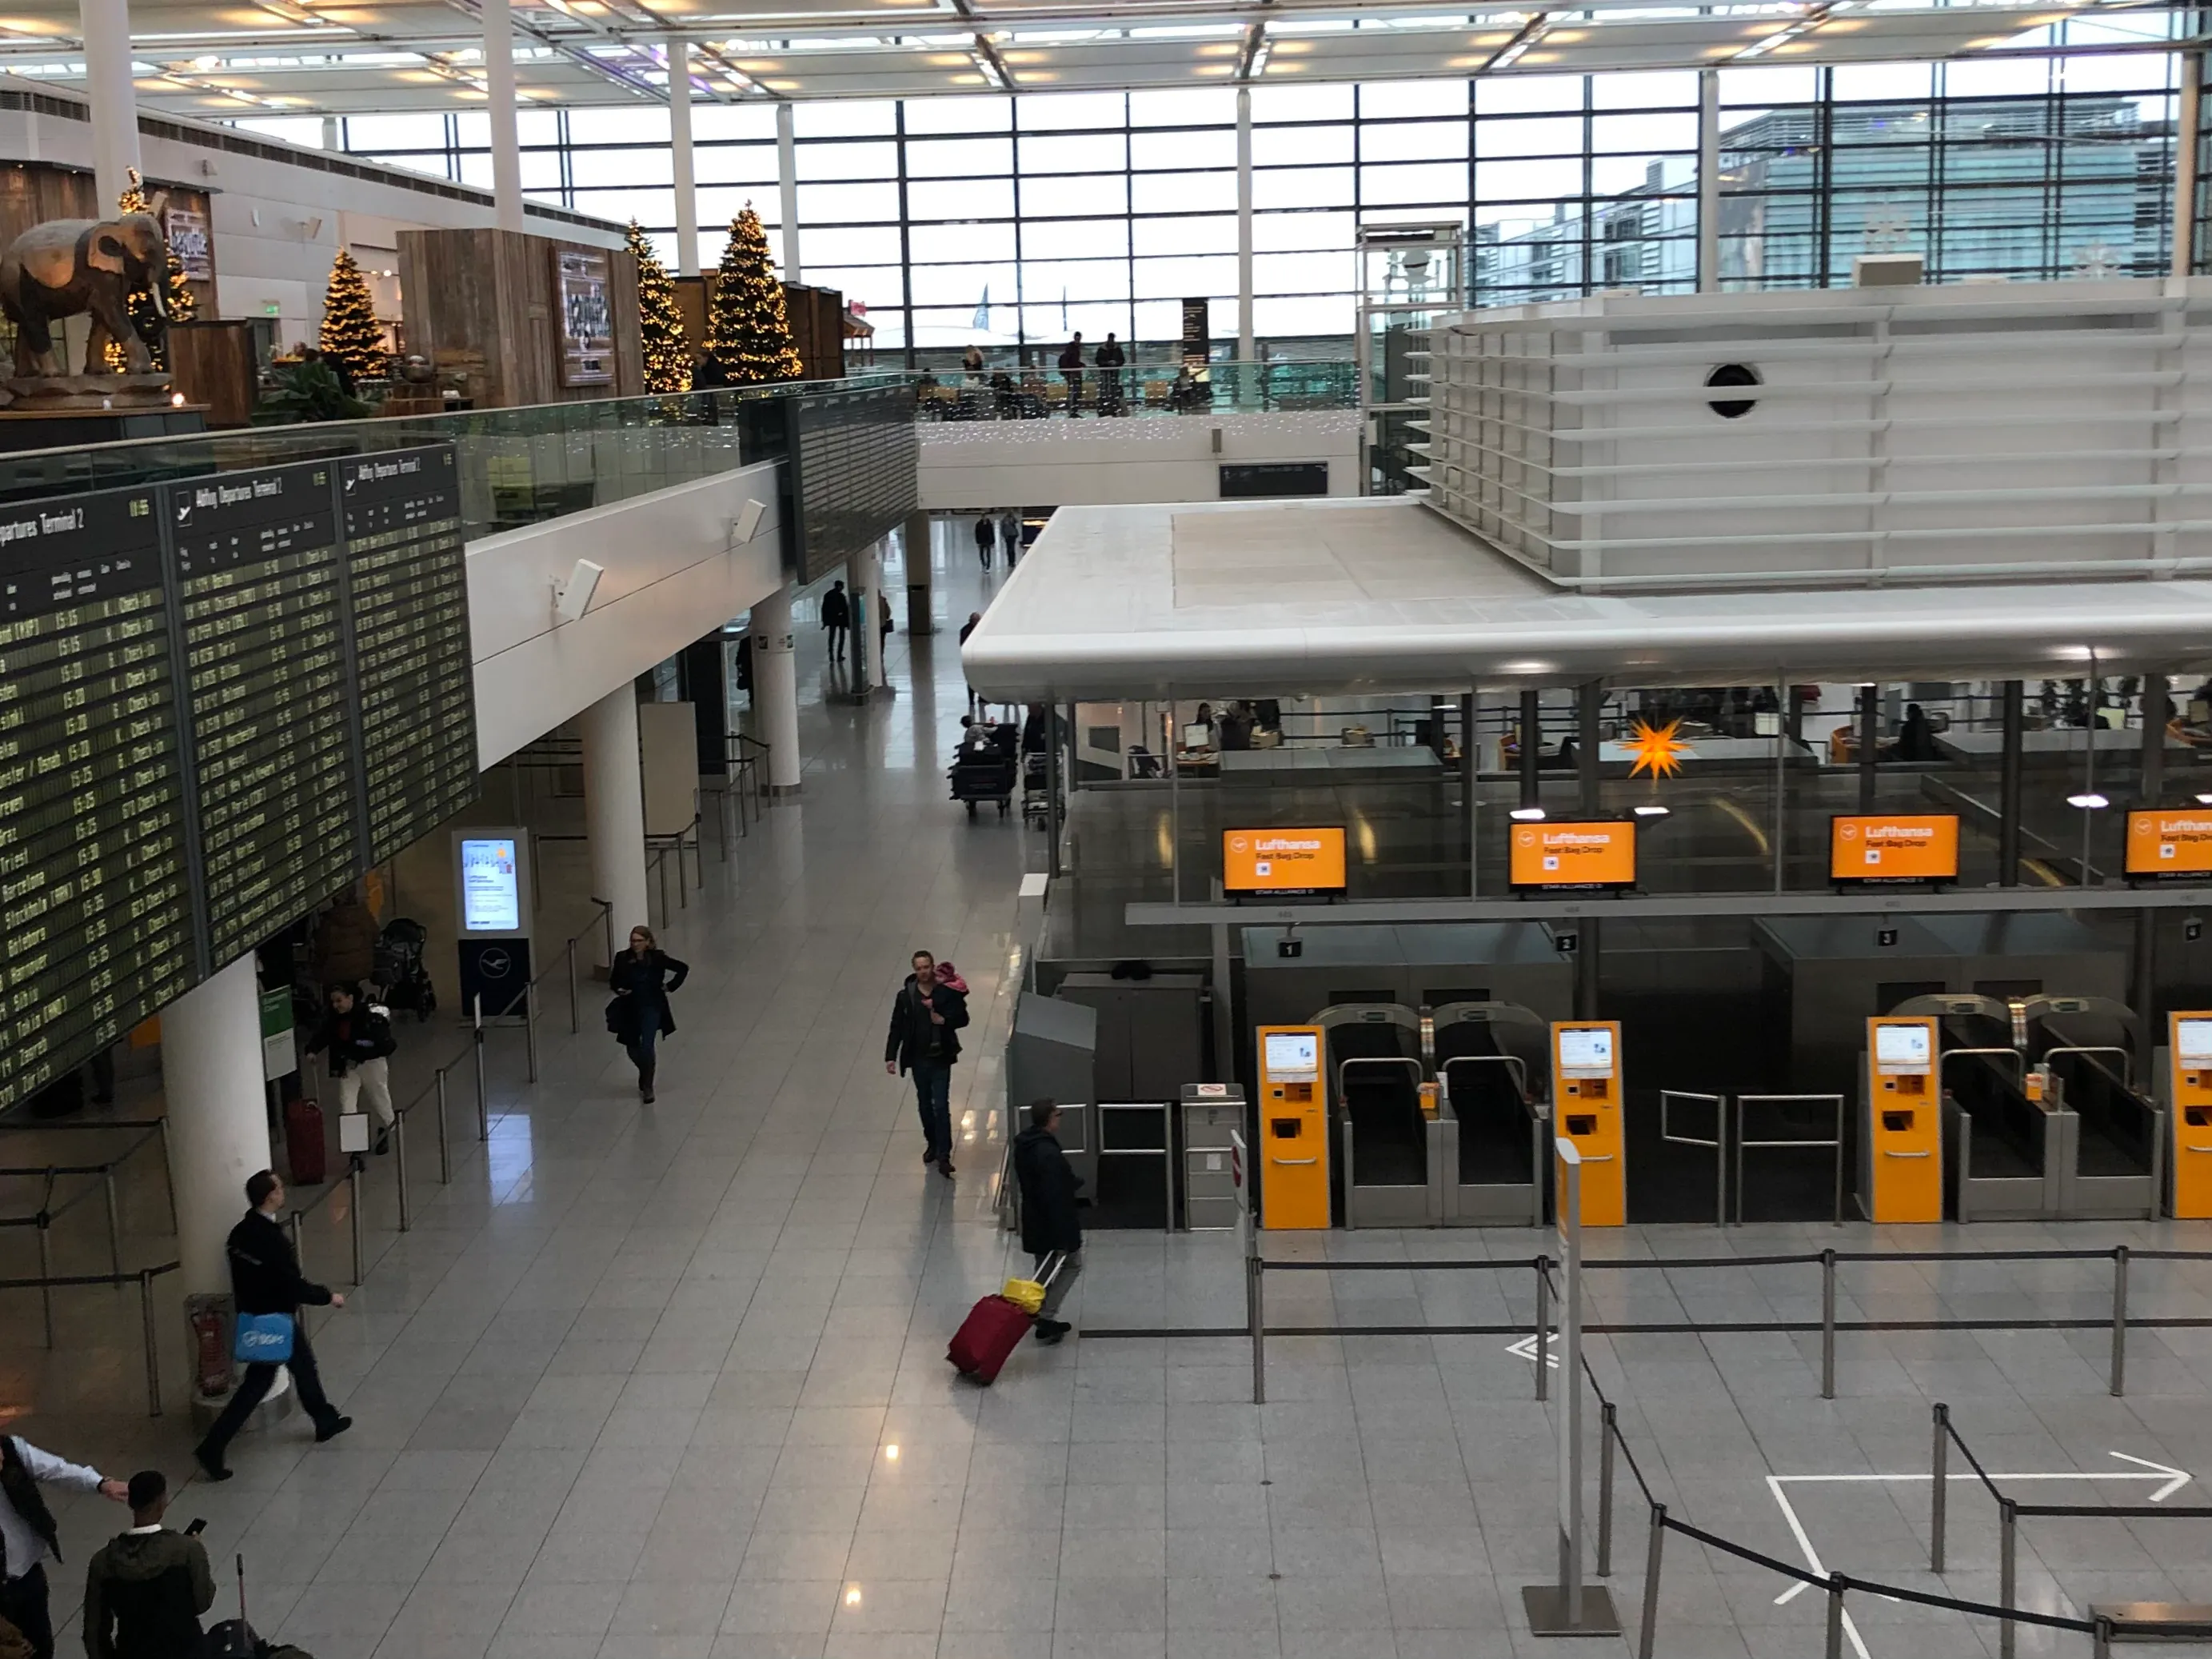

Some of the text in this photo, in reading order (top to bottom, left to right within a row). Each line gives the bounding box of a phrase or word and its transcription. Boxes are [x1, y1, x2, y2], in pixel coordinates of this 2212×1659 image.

[218, 486, 251, 506] Departures
[253, 480, 277, 497] Terminal
[39, 509, 76, 534] Terminal
[77, 508, 84, 529] 2
[1866, 826, 1933, 837] Lufthansa
[1543, 833, 1610, 844] Lufthansa
[1256, 839, 1321, 850] Lufthansa
[1563, 938, 1570, 949] 2
[1883, 933, 1891, 944] 3
[1286, 944, 1293, 955] 1
